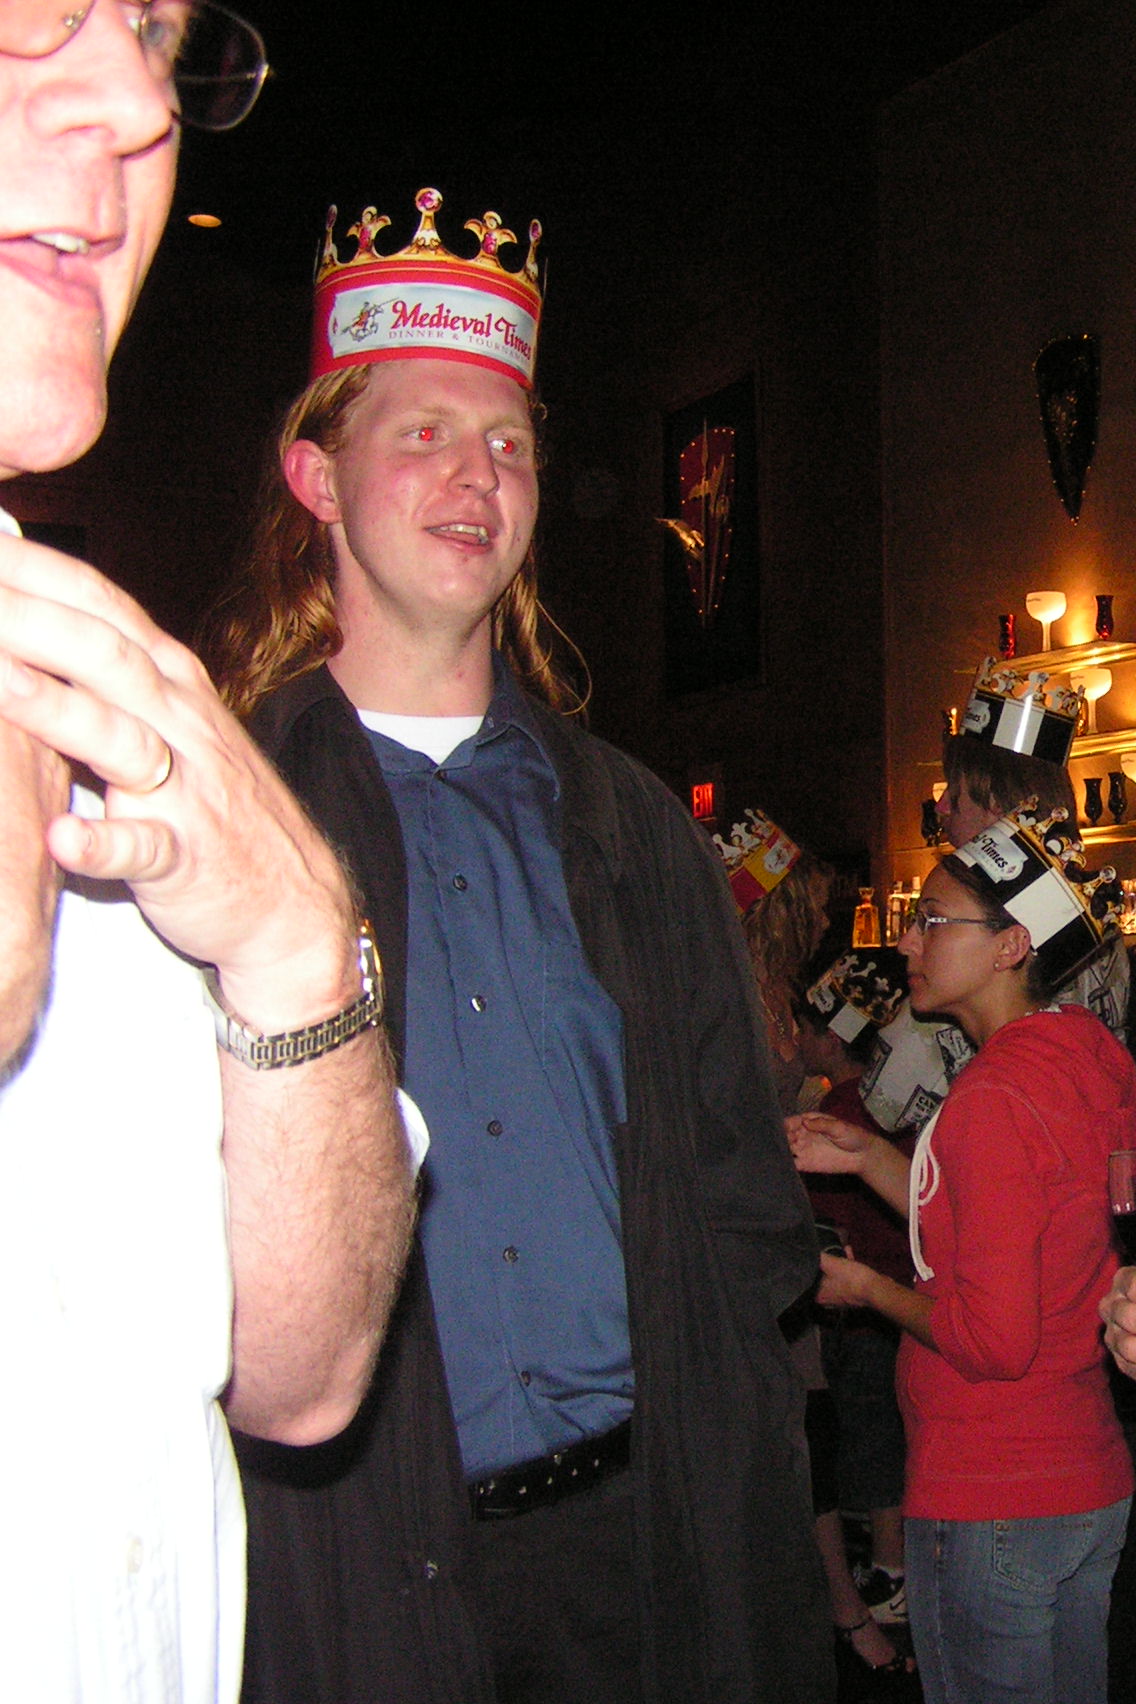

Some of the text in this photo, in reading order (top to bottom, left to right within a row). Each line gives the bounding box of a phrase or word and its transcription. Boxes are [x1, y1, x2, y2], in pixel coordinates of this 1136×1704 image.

[388, 329, 445, 340] DINNER
[390, 300, 532, 361] Medieval Times
[982, 836, 1010, 869] Times
